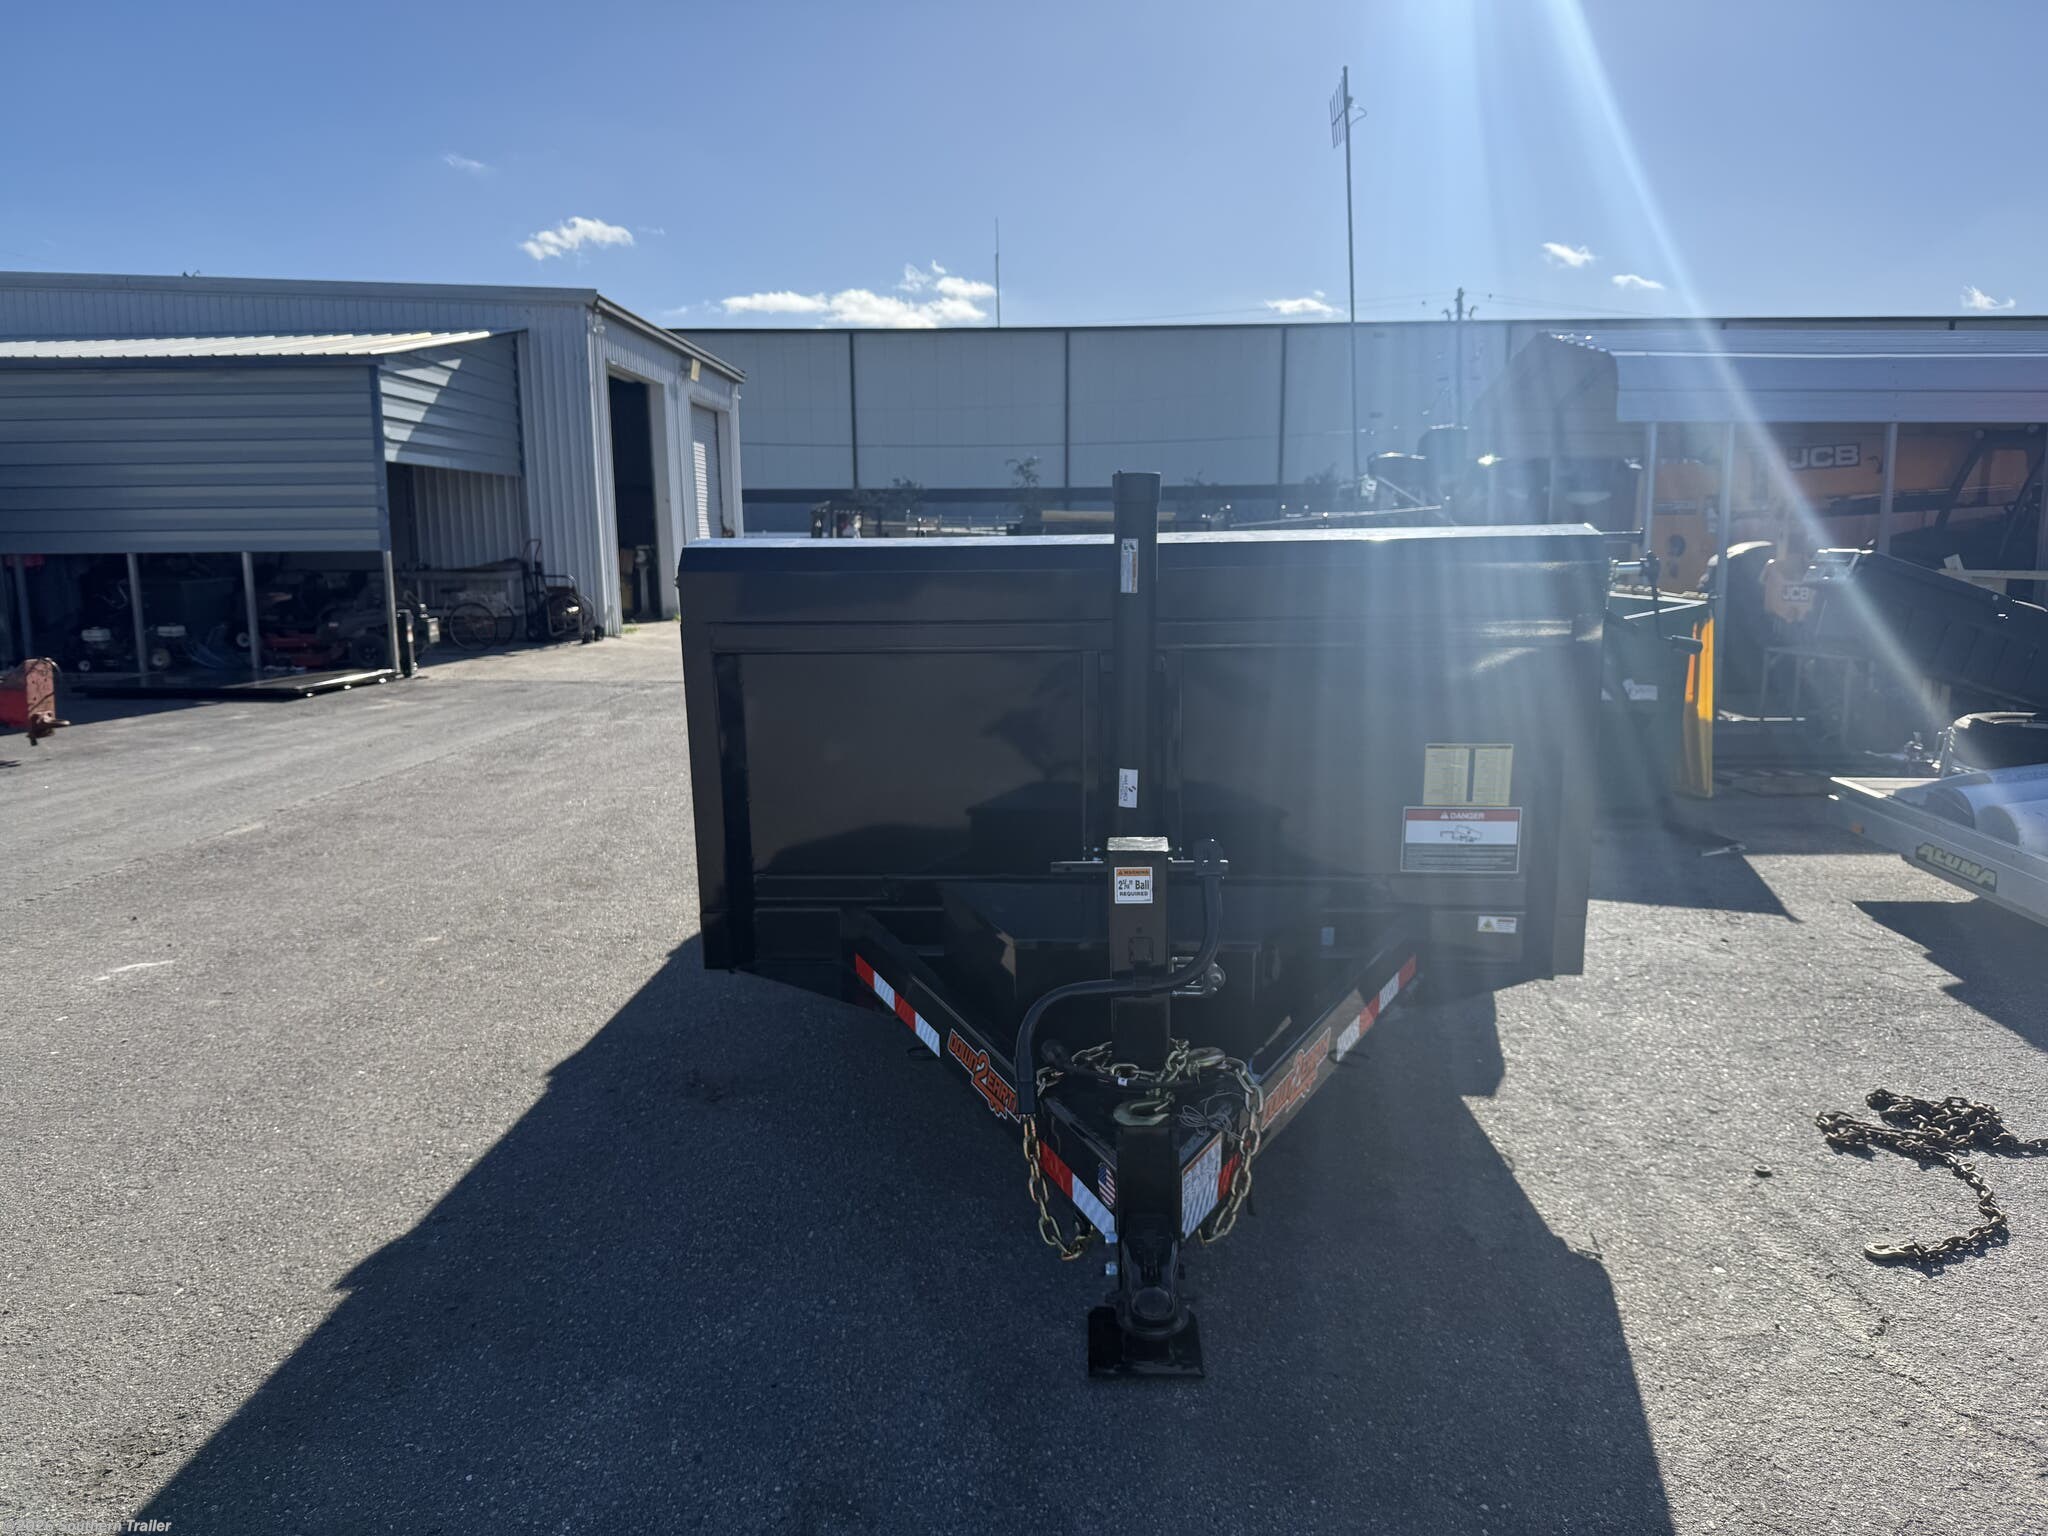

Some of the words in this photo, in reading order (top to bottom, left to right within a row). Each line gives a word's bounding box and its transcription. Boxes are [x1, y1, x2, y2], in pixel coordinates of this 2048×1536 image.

[1789, 445, 1859, 469] JCB
[1783, 586, 1809, 601] JCB
[1450, 812, 1486, 820] DANGER
[1917, 844, 1996, 888] ALUMA
[1135, 880, 1150, 890] Ball
